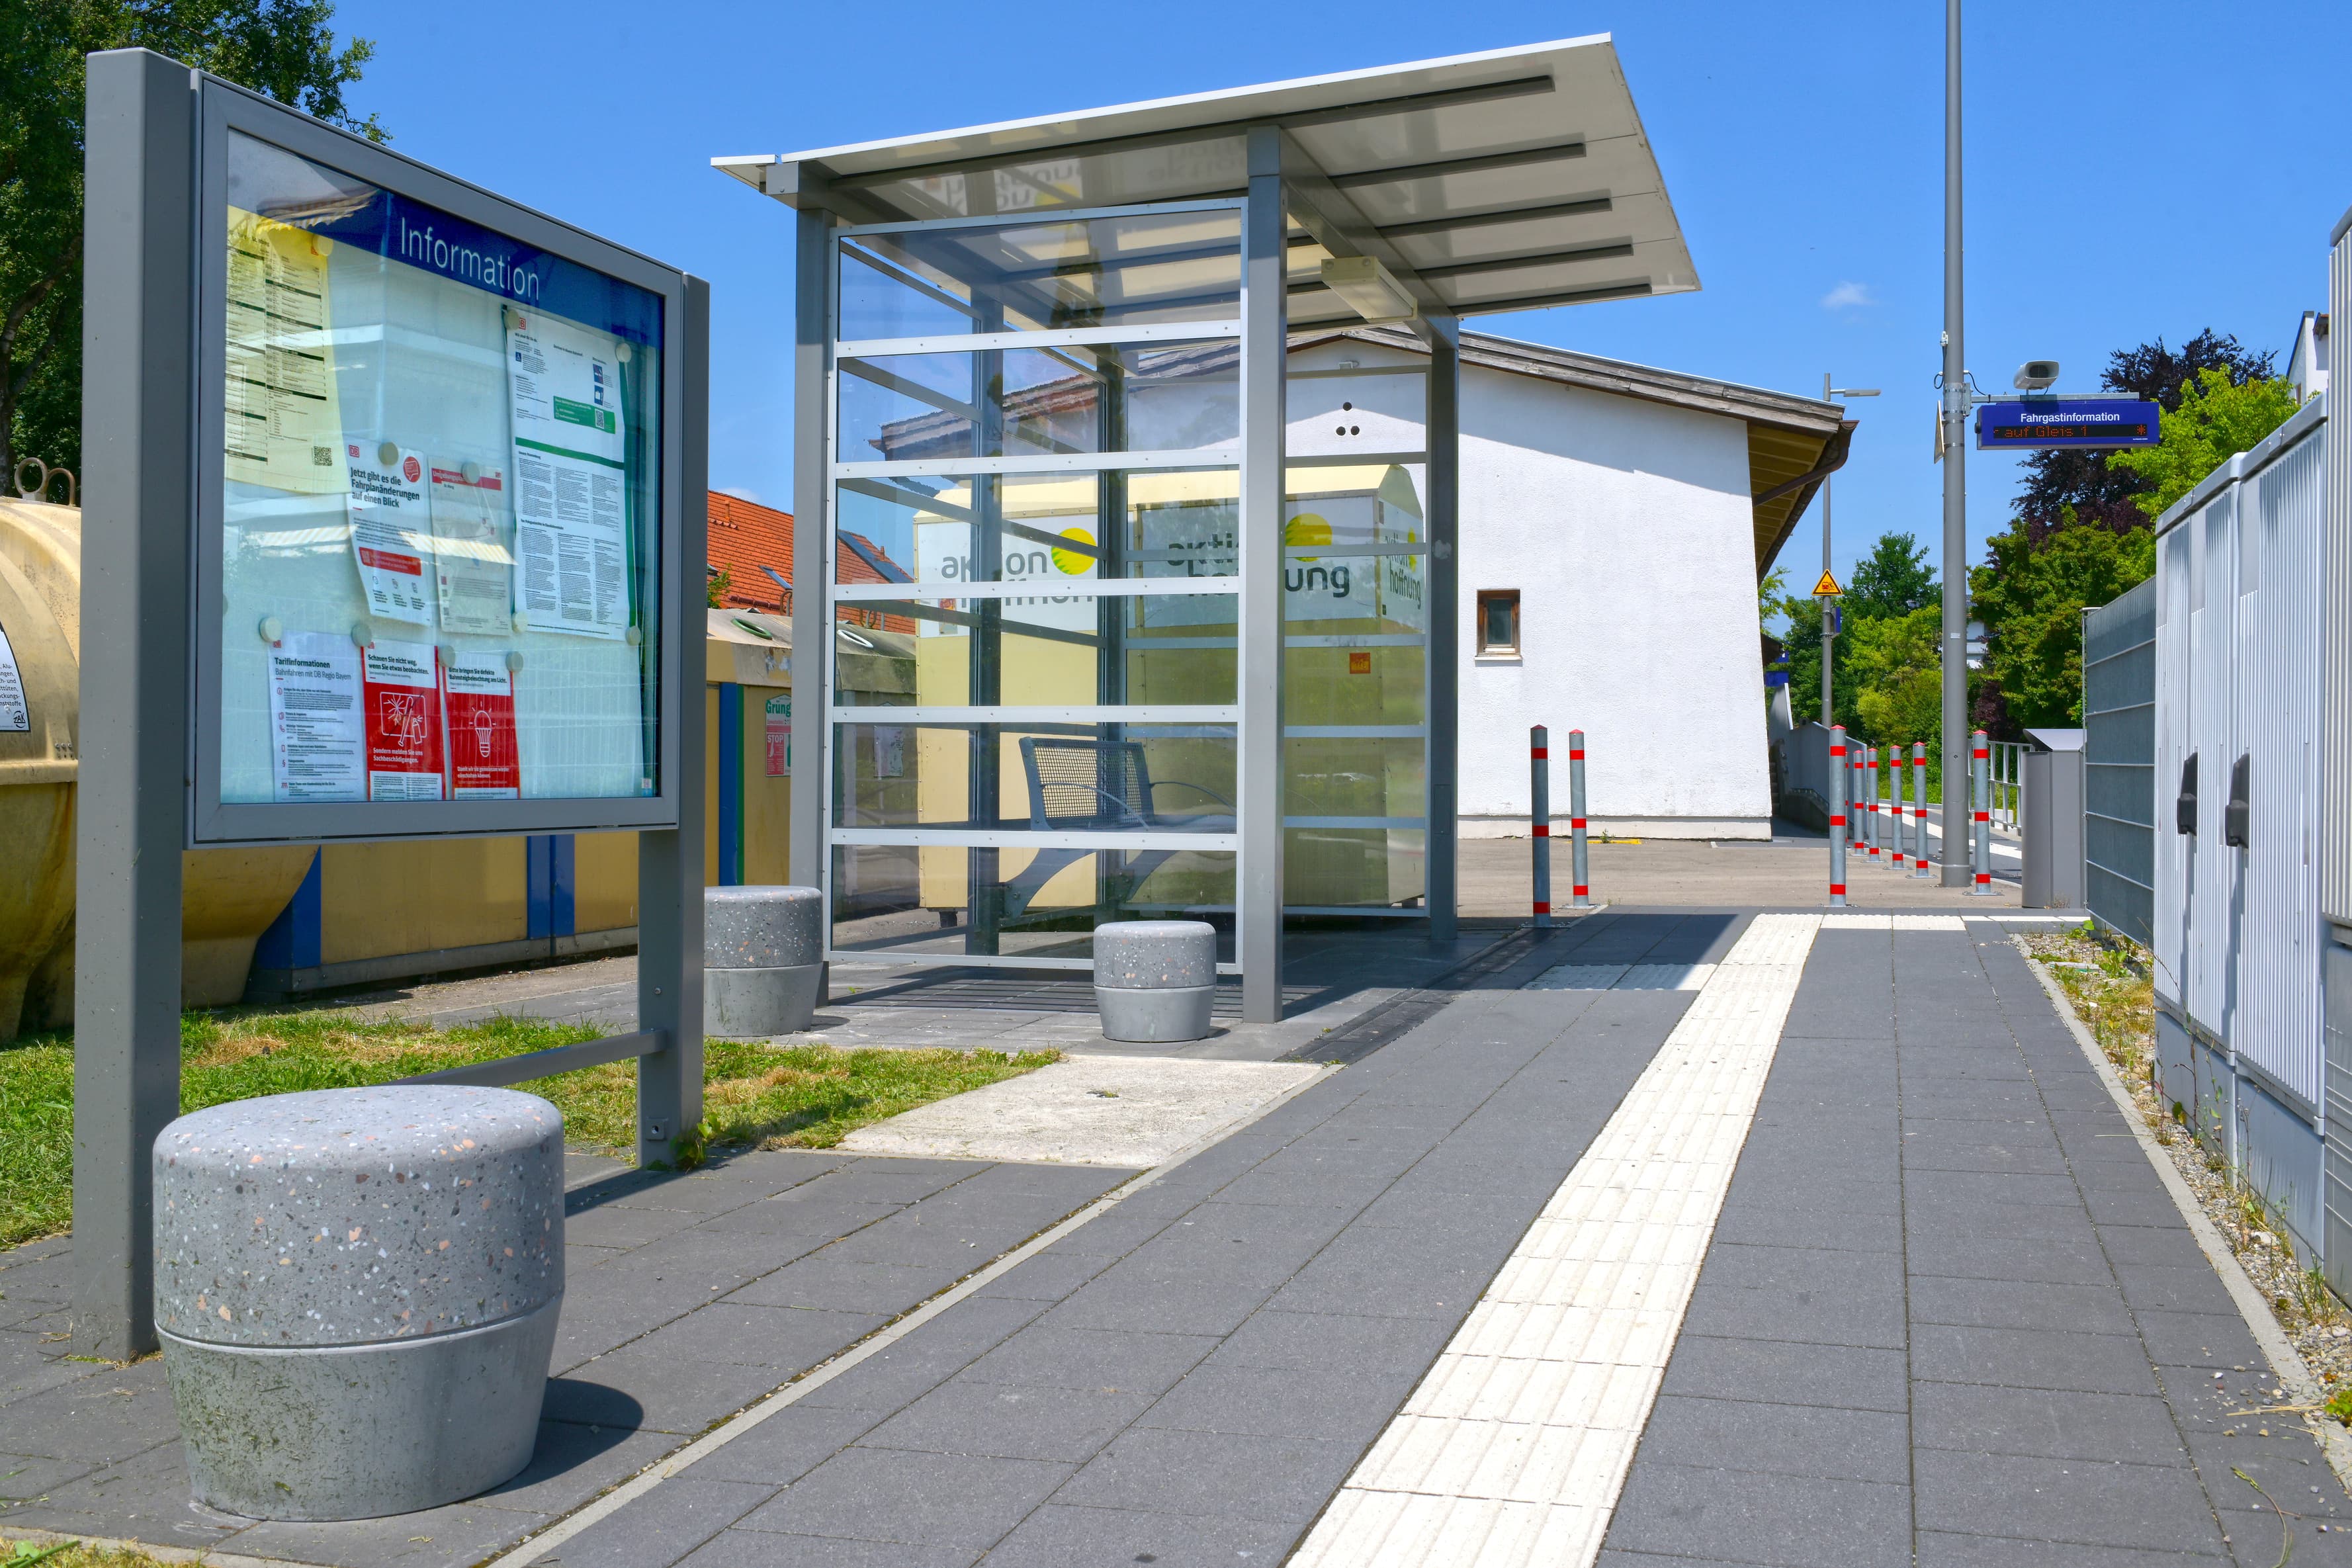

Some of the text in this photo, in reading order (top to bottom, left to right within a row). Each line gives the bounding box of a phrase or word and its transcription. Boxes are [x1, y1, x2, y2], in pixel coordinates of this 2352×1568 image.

[402, 216, 539, 300] Information
[2021, 412, 2120, 424] Fahrgastinformation
[2005, 425, 2086, 437] auf Gleis 1
[349, 445, 359, 457] DB
[351, 467, 366, 478] Jetzt
[367, 471, 380, 482] gibt
[390, 476, 402, 486] die
[433, 470, 466, 482] Umgebungspla
[351, 478, 419, 501] Fahrplanänderungen
[352, 492, 400, 508] auf einen Blick
[941, 550, 1047, 580] akon
[275, 657, 330, 668] Tarifinformationen
[275, 668, 304, 677] Bahnfahren
[322, 671, 335, 680] Regio
[335, 672, 351, 681] Bayern
[765, 699, 791, 718] Grüng
[13, 713, 26, 724] ZAK
[373, 755, 418, 764] Sachbeschädigungen.
